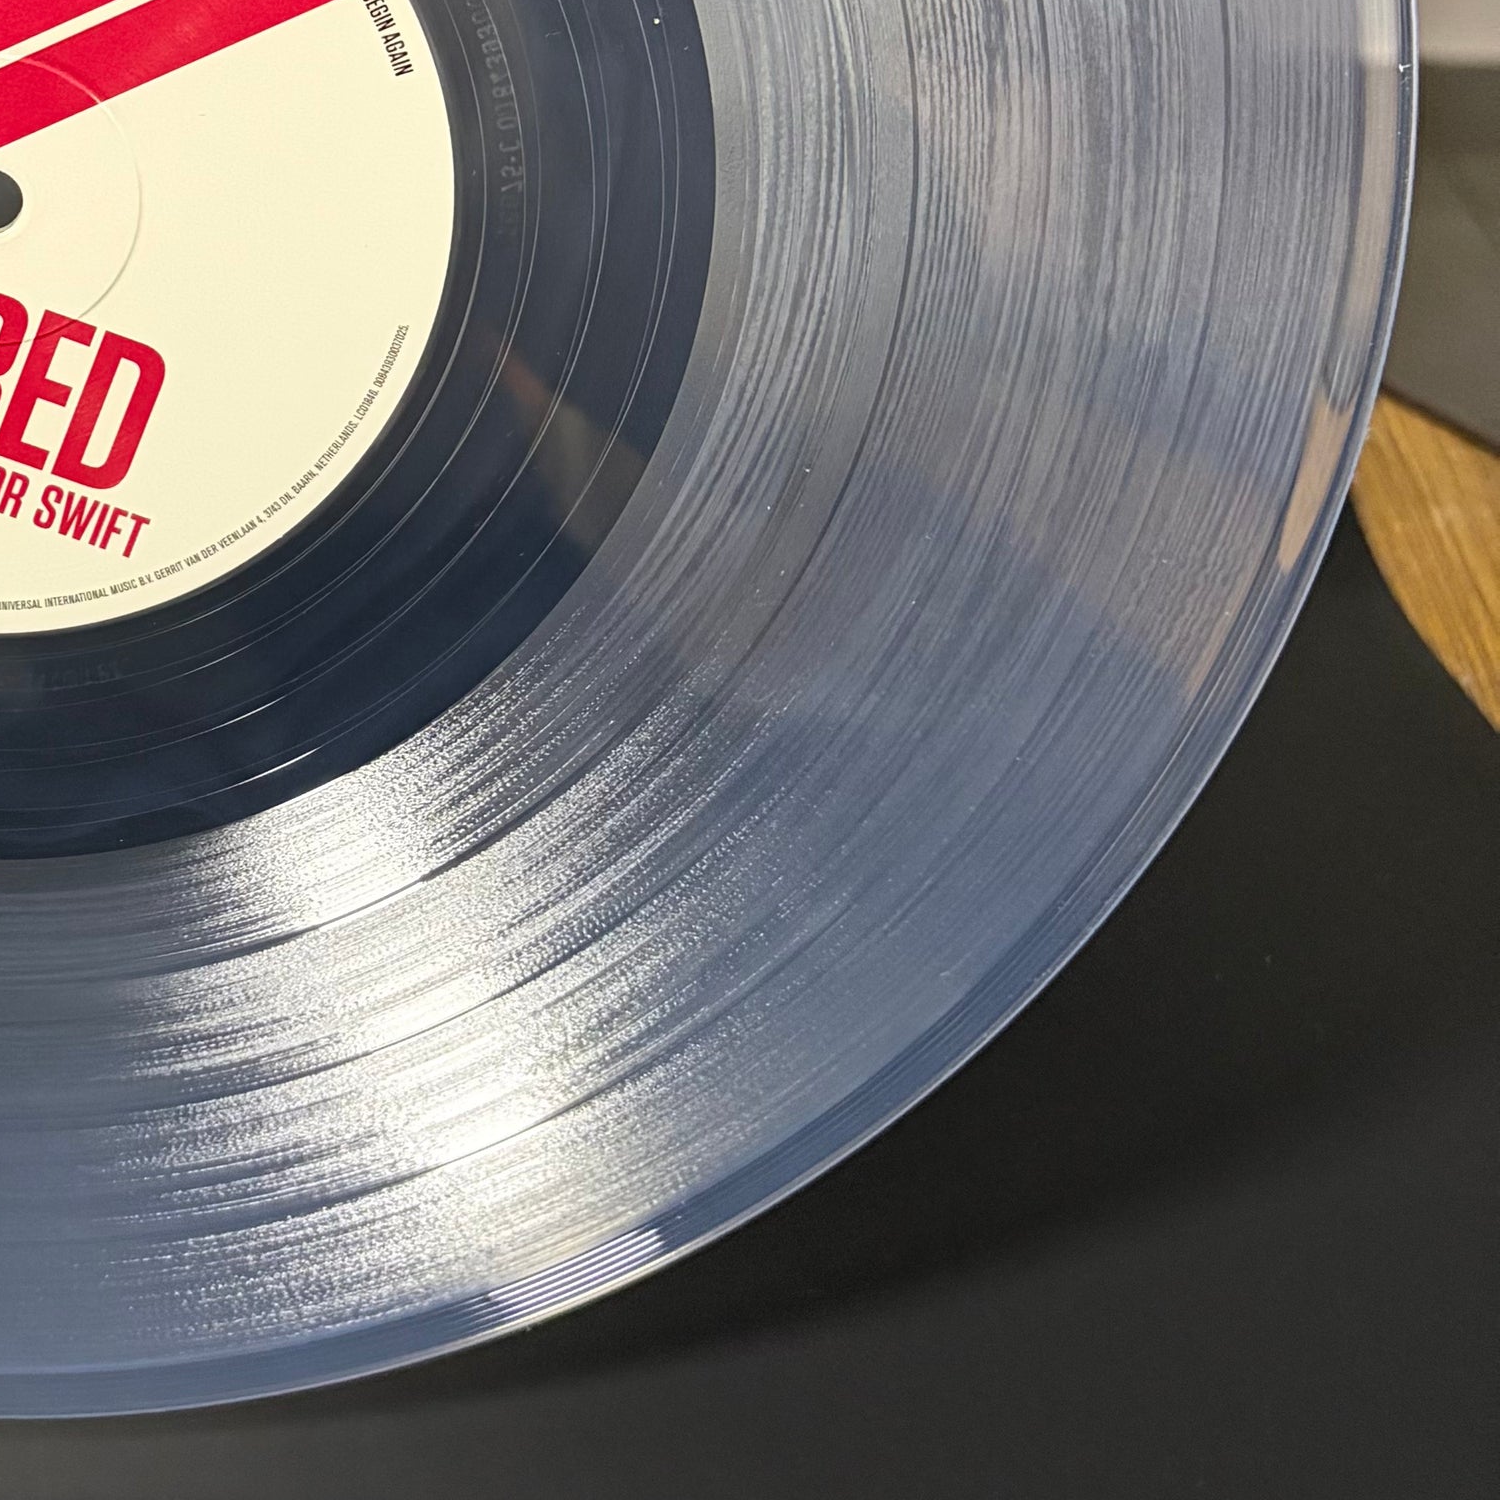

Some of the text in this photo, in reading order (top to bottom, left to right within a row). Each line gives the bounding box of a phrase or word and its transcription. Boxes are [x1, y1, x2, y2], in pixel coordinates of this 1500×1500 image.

[381, 32, 414, 77] AGAIN
[32, 483, 151, 559] SWIFT
[44, 588, 109, 607] INTERNATIONAL
[109, 578, 138, 595] MUSIC
[137, 573, 154, 587] B.V.
[153, 561, 184, 581] GERRIT
[183, 555, 202, 570] VAN
[200, 544, 220, 560] DER
[217, 519, 258, 550] VEENLAAN
[257, 514, 267, 524] 4,
[262, 500, 283, 519] 3743
[290, 469, 319, 495] BAARN,
[314, 420, 360, 471] NETHERLANDS.
[353, 388, 380, 421] LC01846.
